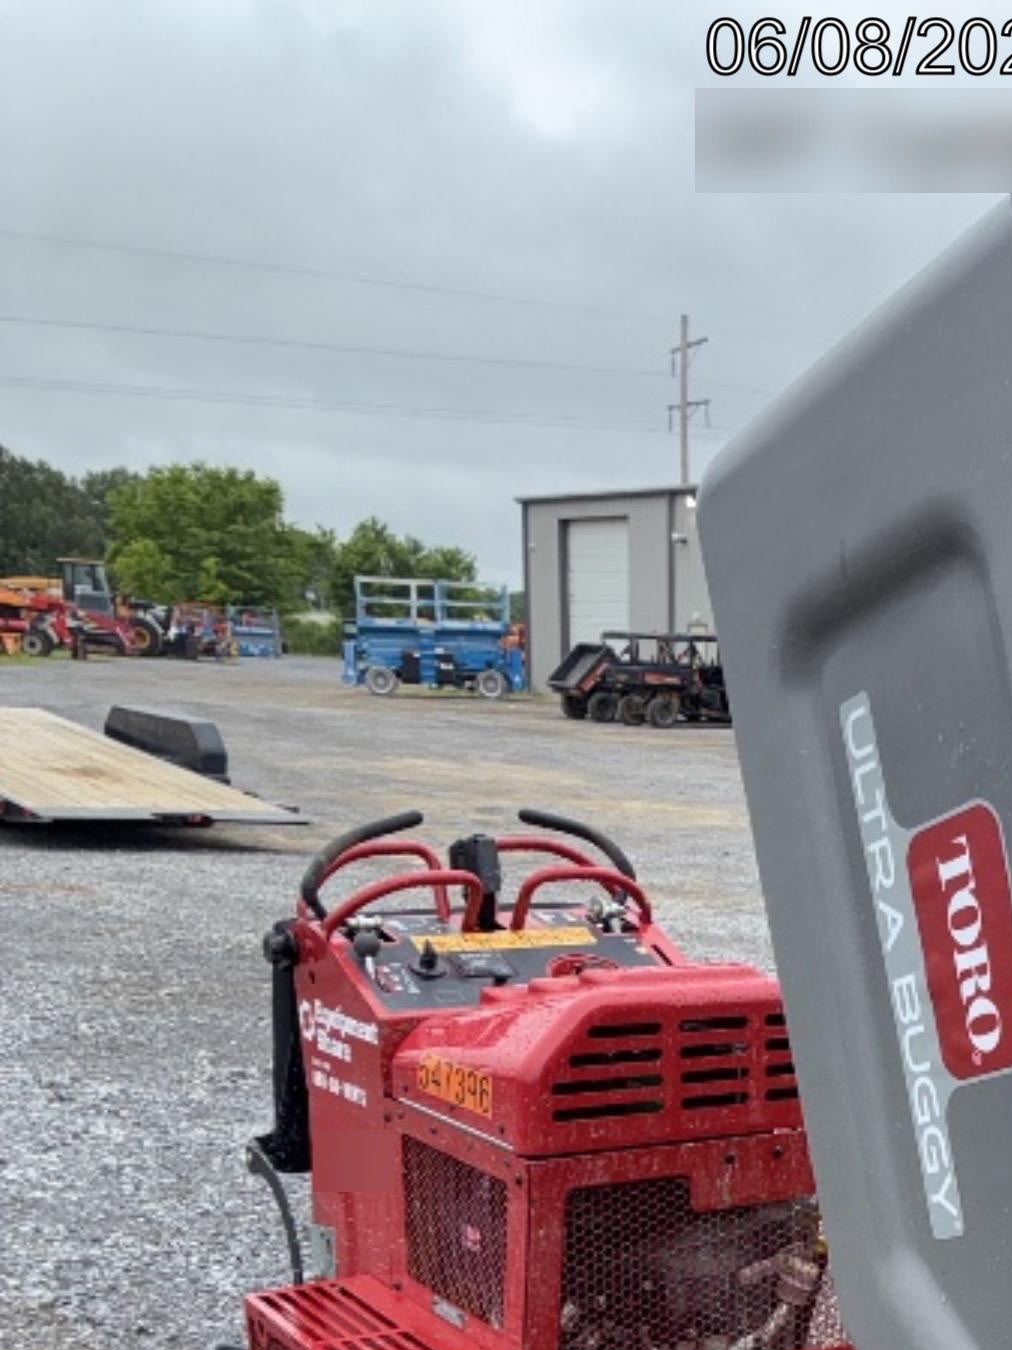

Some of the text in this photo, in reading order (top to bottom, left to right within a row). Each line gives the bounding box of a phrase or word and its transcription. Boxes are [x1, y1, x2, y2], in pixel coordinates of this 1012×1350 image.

[848, 704, 959, 1217] ULTRA BUGGY
[936, 834, 1002, 1052] TORO
